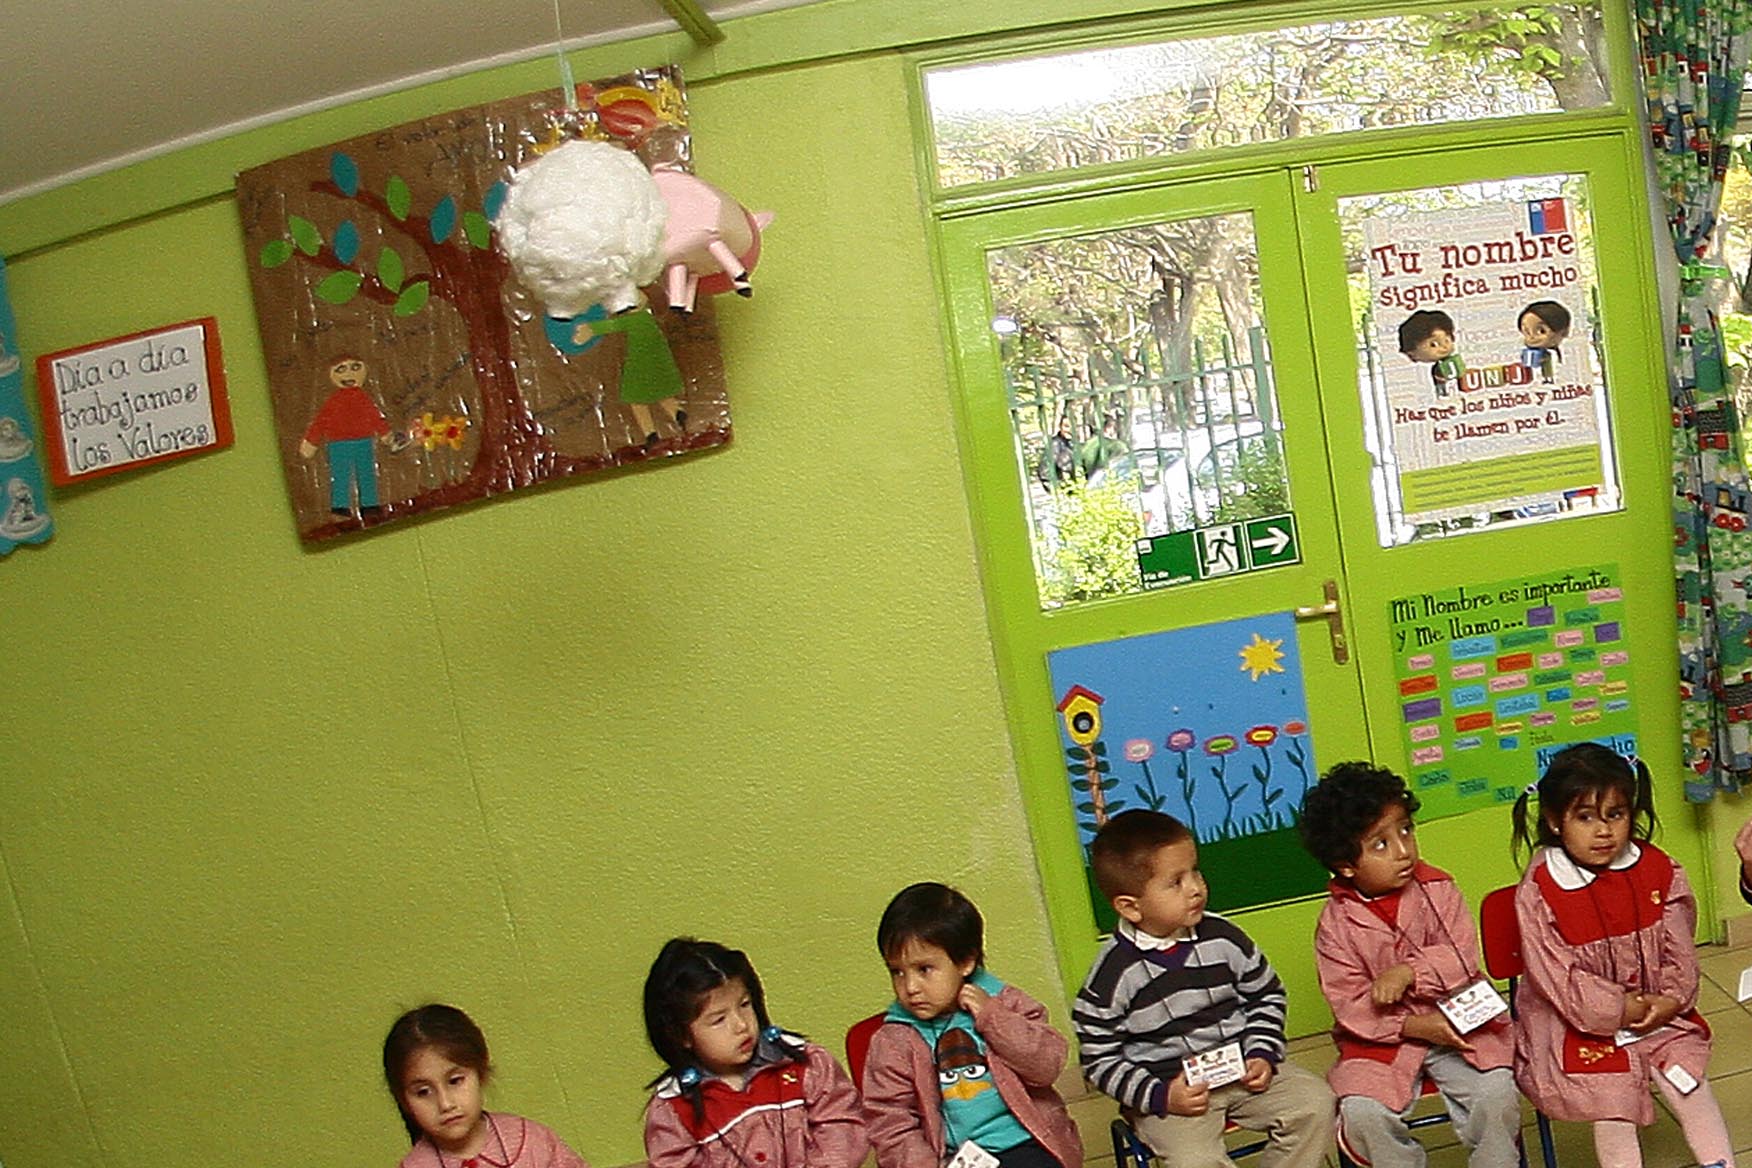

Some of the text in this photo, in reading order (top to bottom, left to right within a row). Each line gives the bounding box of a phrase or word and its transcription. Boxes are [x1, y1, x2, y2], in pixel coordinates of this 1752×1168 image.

[1371, 232, 1575, 277] Tu nombre
[1380, 265, 1578, 311] significa mucho
[108, 357, 130, 380] a
[60, 381, 199, 430] trabajamos
[1395, 383, 1593, 424] Haz que los niños y niñas
[117, 422, 209, 460] Valores
[1434, 427, 1450, 443] te
[1455, 421, 1509, 440] llamen
[1515, 417, 1540, 434] por
[1393, 569, 1611, 623] Mi Nombre es importante
[1396, 630, 1406, 652] y
[1416, 626, 1445, 647] Me
